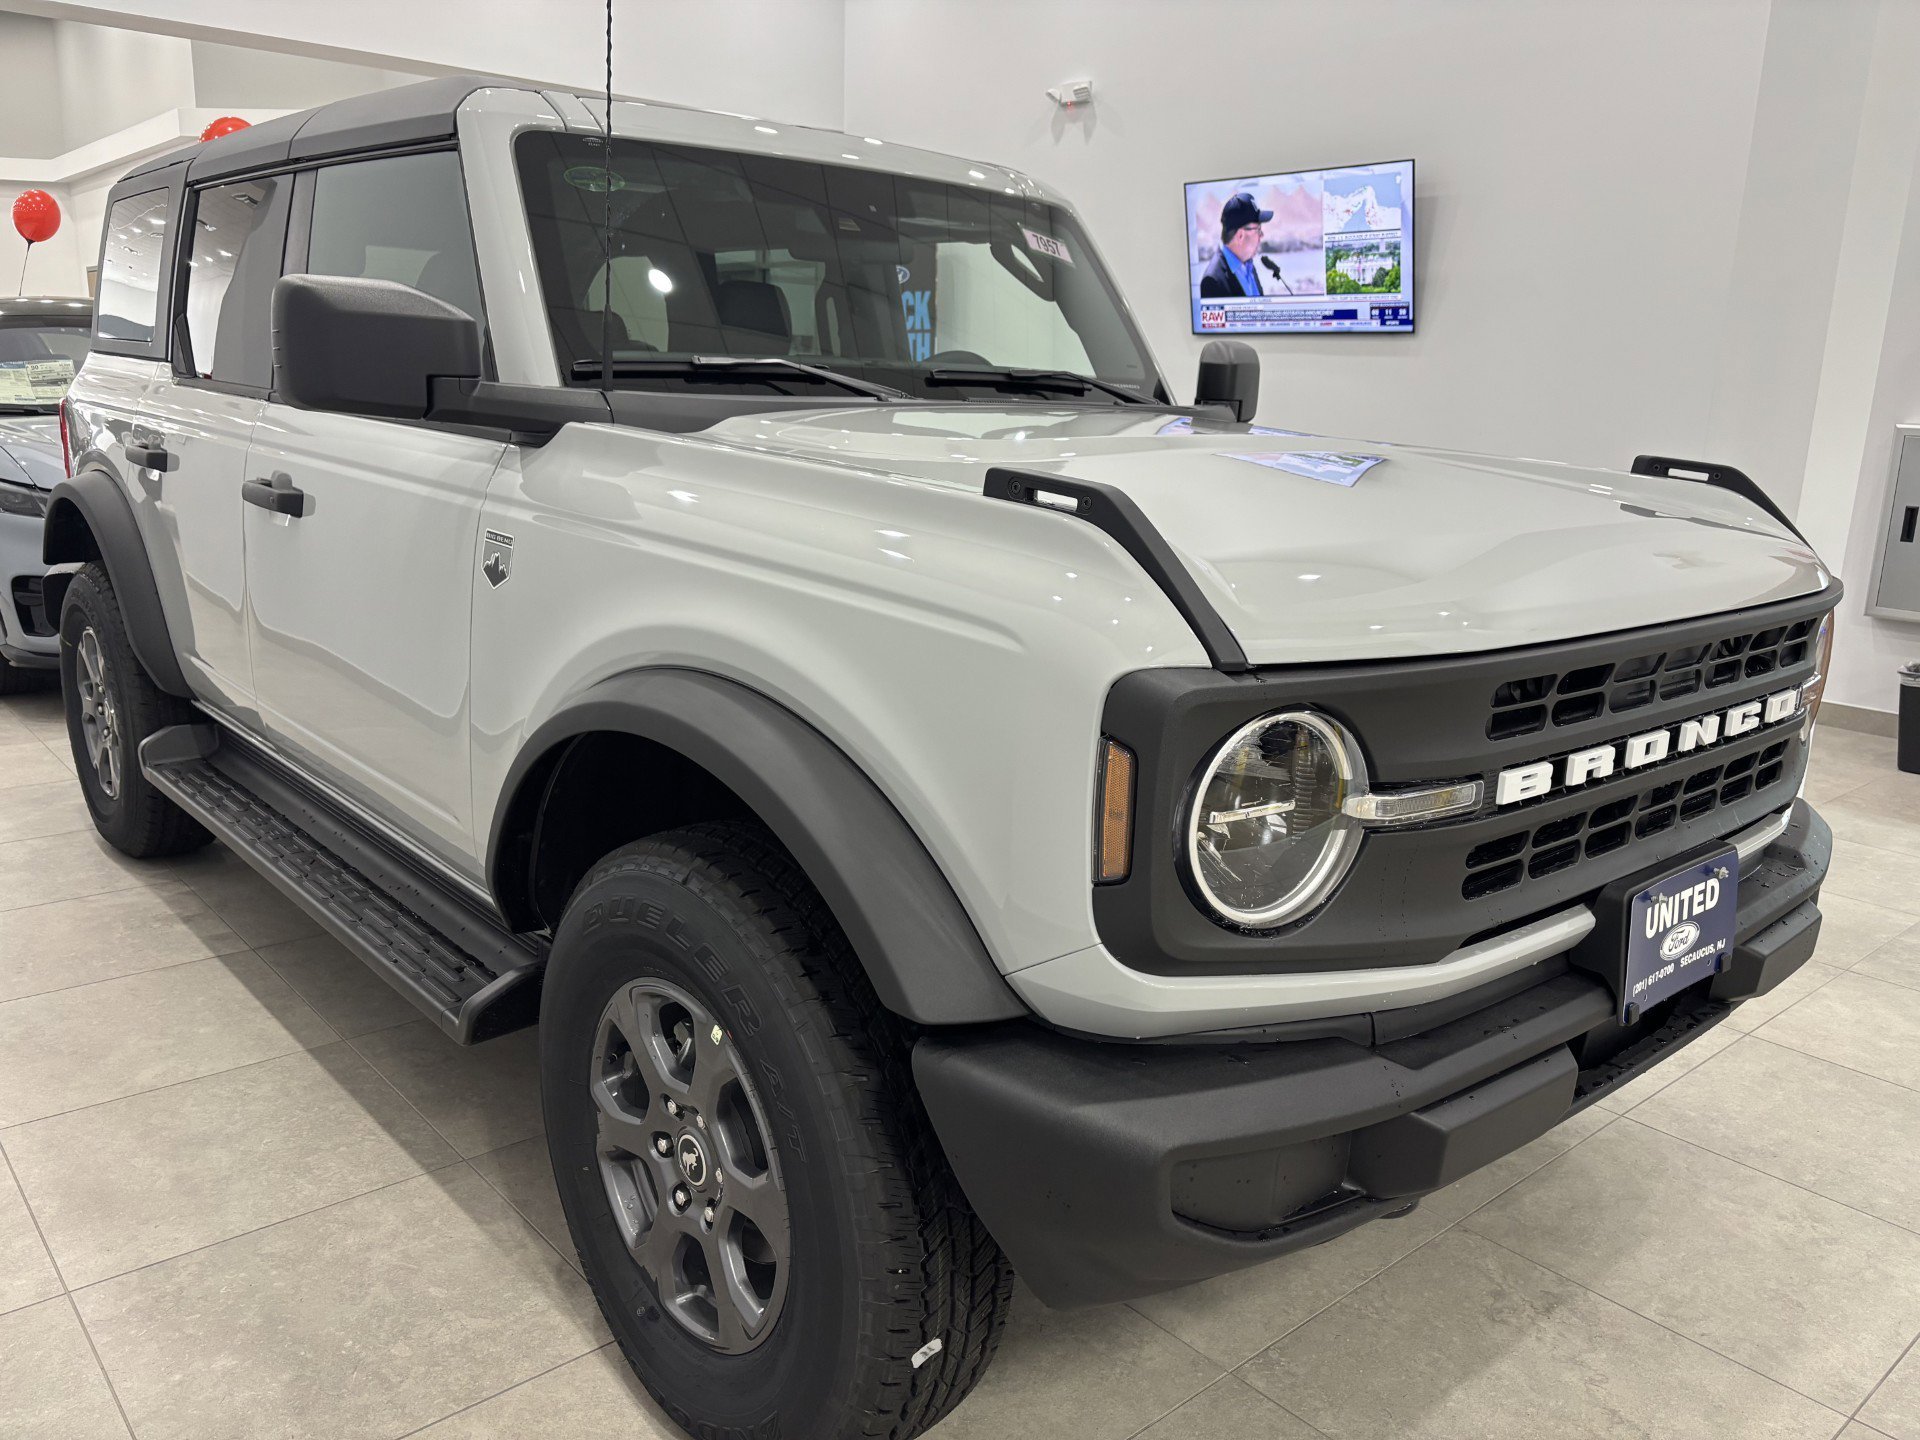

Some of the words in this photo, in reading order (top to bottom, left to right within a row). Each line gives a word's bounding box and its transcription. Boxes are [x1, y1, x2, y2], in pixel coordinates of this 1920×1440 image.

[1031, 233, 1061, 257] 7957
[1202, 311, 1223, 321] RAW
[1495, 689, 1798, 805] BRONCO
[1645, 878, 1720, 939] UNITED
[1668, 929, 1691, 953] Ford
[1680, 943, 1716, 968] SECAUCUS,
[1716, 938, 1726, 954] NJ
